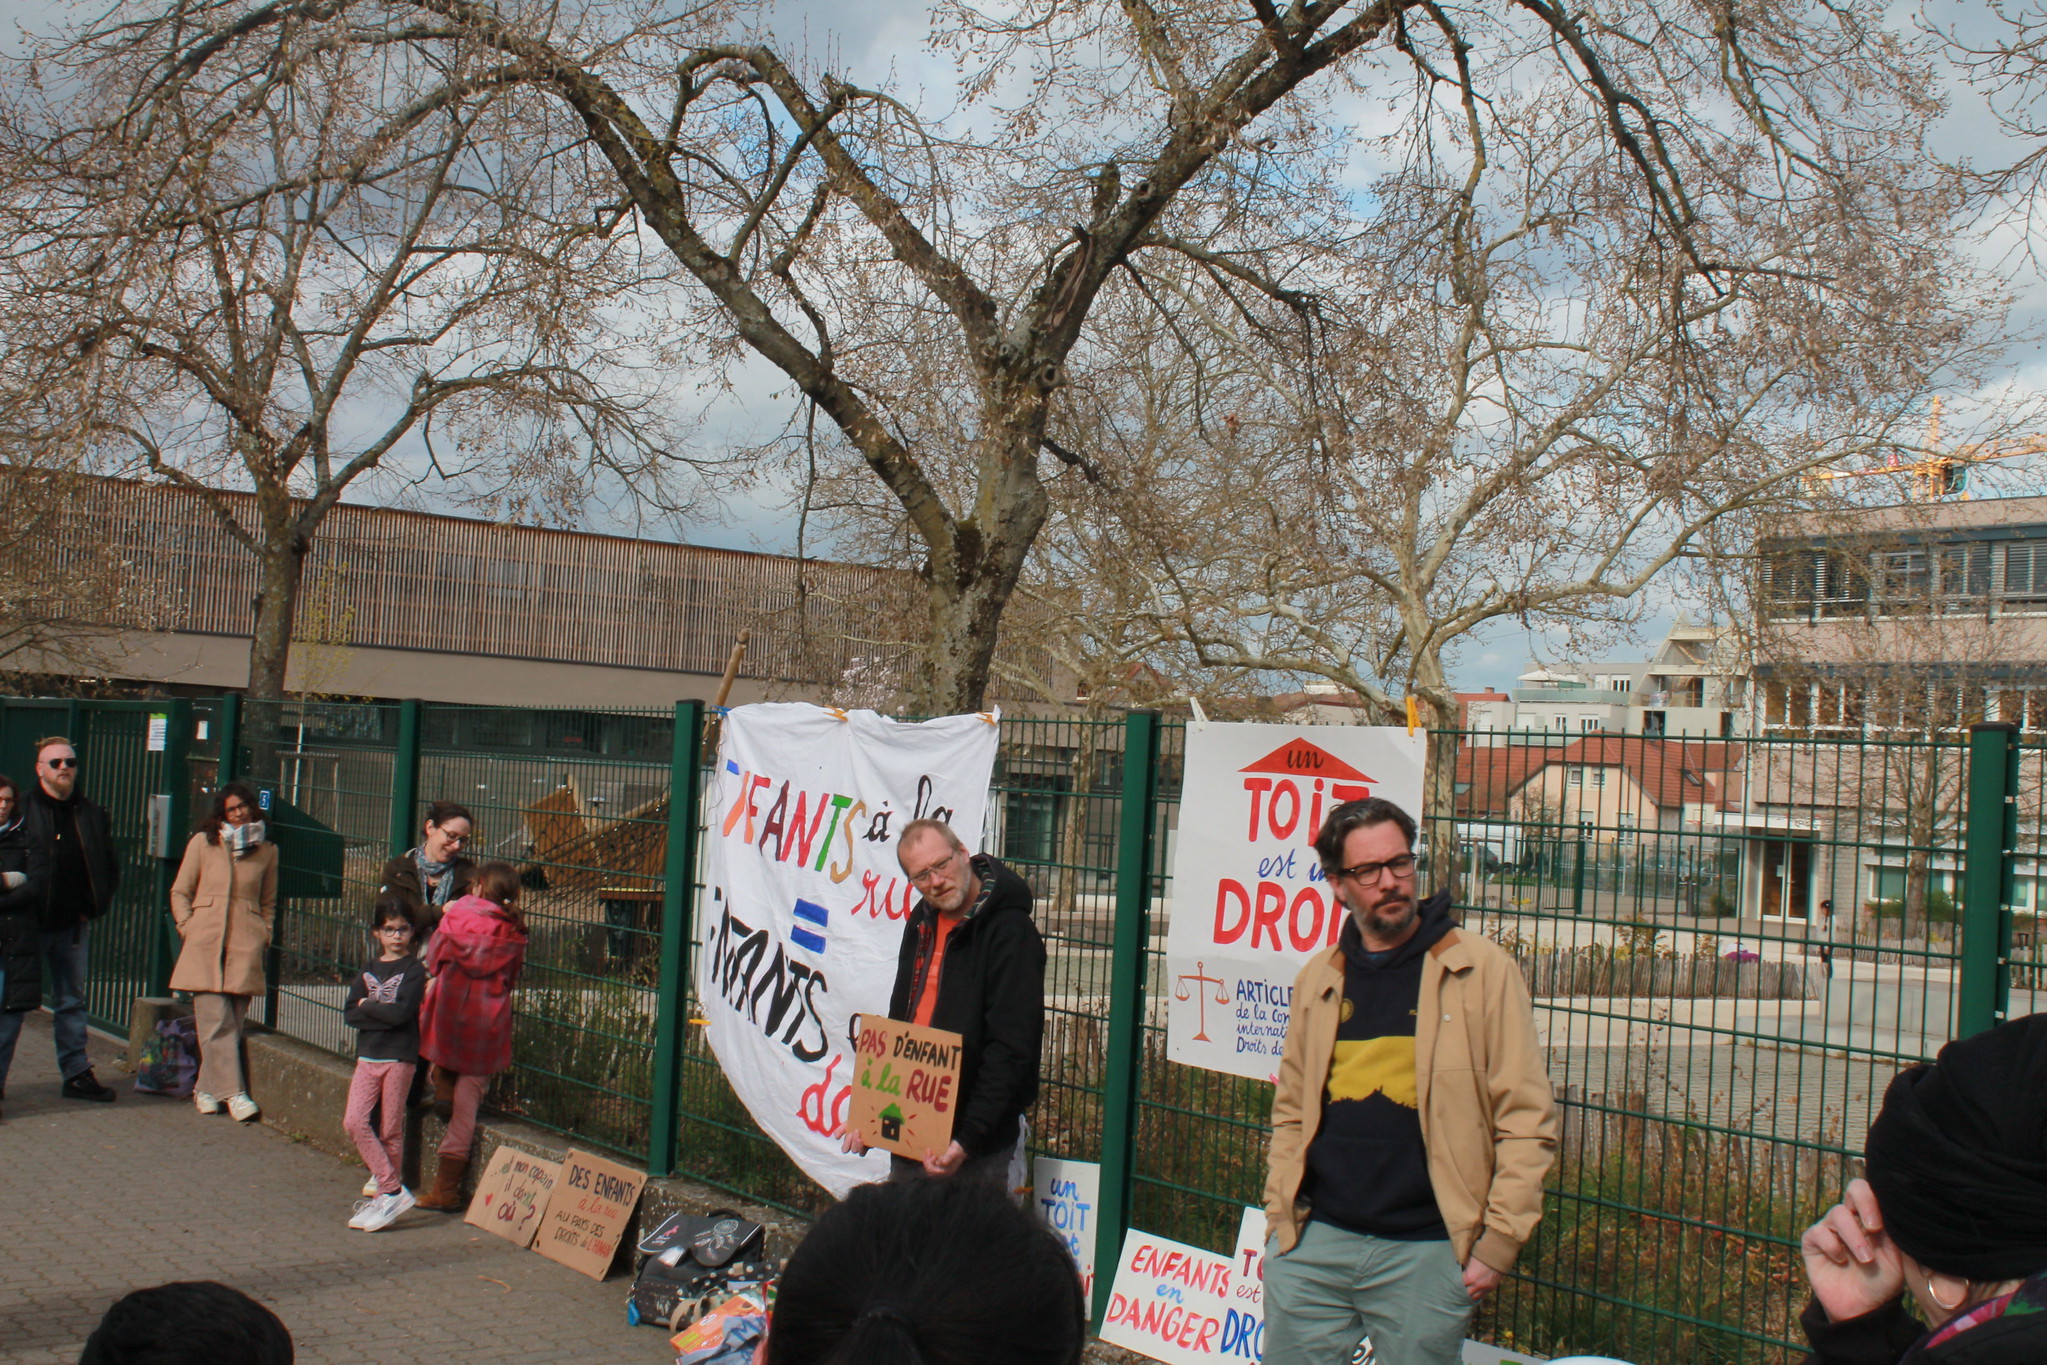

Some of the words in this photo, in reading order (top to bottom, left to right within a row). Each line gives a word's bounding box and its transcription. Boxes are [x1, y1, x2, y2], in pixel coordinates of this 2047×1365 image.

[1287, 750, 1325, 769] un
[1257, 849, 1297, 880] est
[1235, 1001, 1250, 1019] de
[1254, 1003, 1267, 1020] la
[859, 1028, 888, 1058] PAS
[1236, 1036, 1267, 1055] Droits
[861, 1058, 873, 1089] à
[876, 1062, 902, 1096] la
[906, 1068, 952, 1113] RUE
[528, 1164, 554, 1190] copain
[568, 1164, 591, 1190] DES
[594, 1172, 636, 1207] ENFANTS
[1050, 1177, 1079, 1201] un
[518, 1203, 536, 1231] ?
[554, 1210, 571, 1223] AU
[570, 1215, 590, 1232] PAYS
[589, 1222, 605, 1238] DES
[1130, 1244, 1233, 1299] ENFANTS
[1156, 1283, 1185, 1304] en
[1236, 1284, 1262, 1304] est
[1105, 1291, 1220, 1354] DANGER
